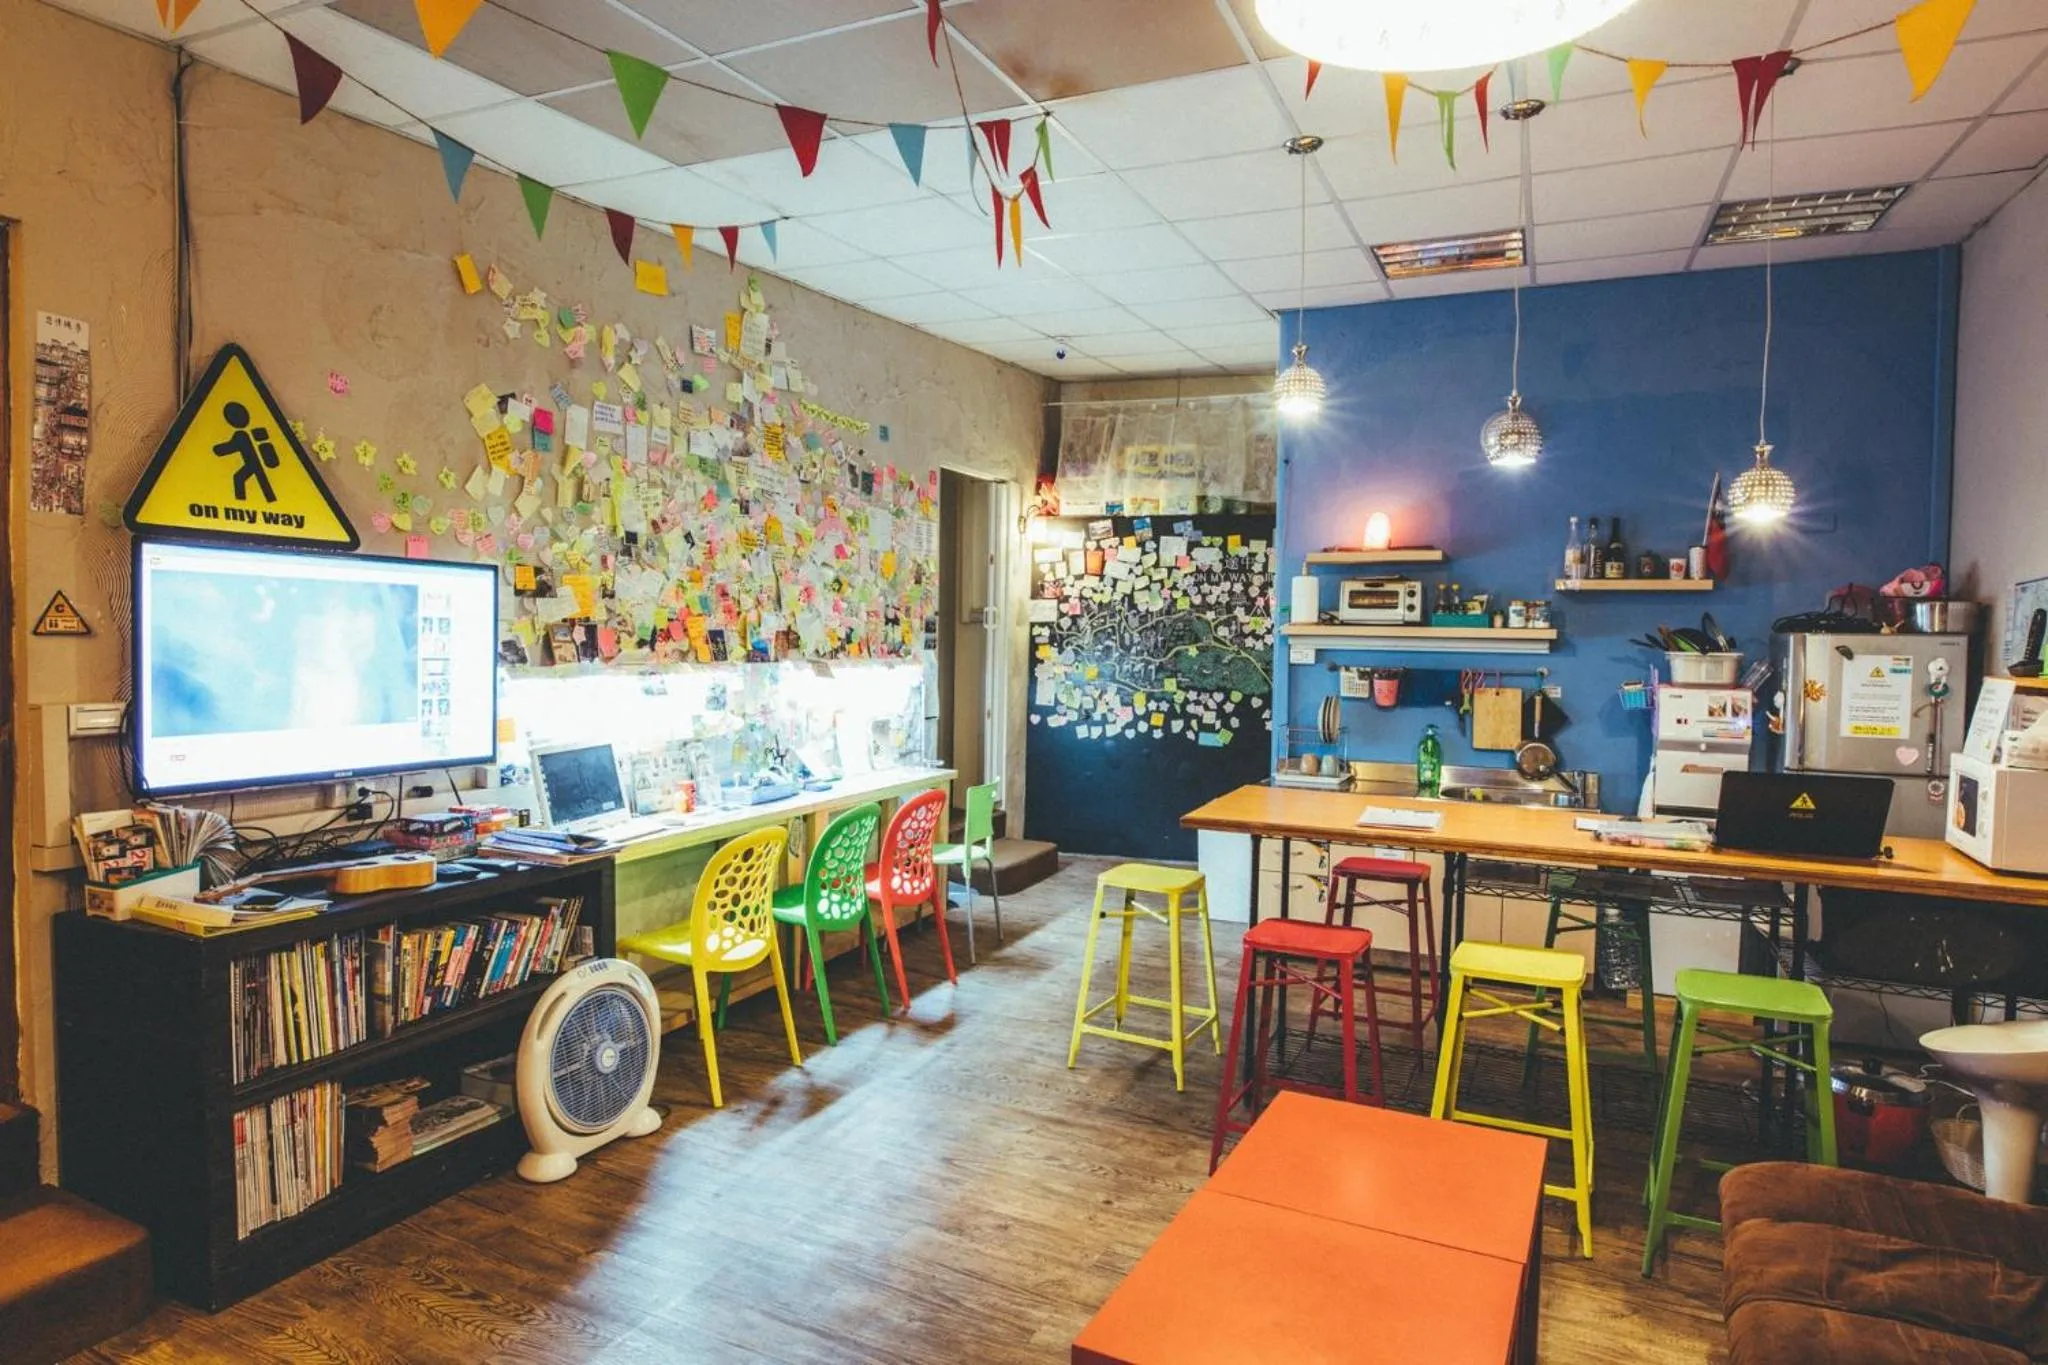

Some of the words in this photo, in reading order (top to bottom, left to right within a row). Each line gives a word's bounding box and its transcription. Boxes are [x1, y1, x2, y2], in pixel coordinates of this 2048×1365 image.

[189, 503, 219, 519] on
[224, 507, 257, 524] my
[262, 511, 305, 529] way
[1211, 572, 1225, 581] MY
[1229, 572, 1253, 582] WAY
